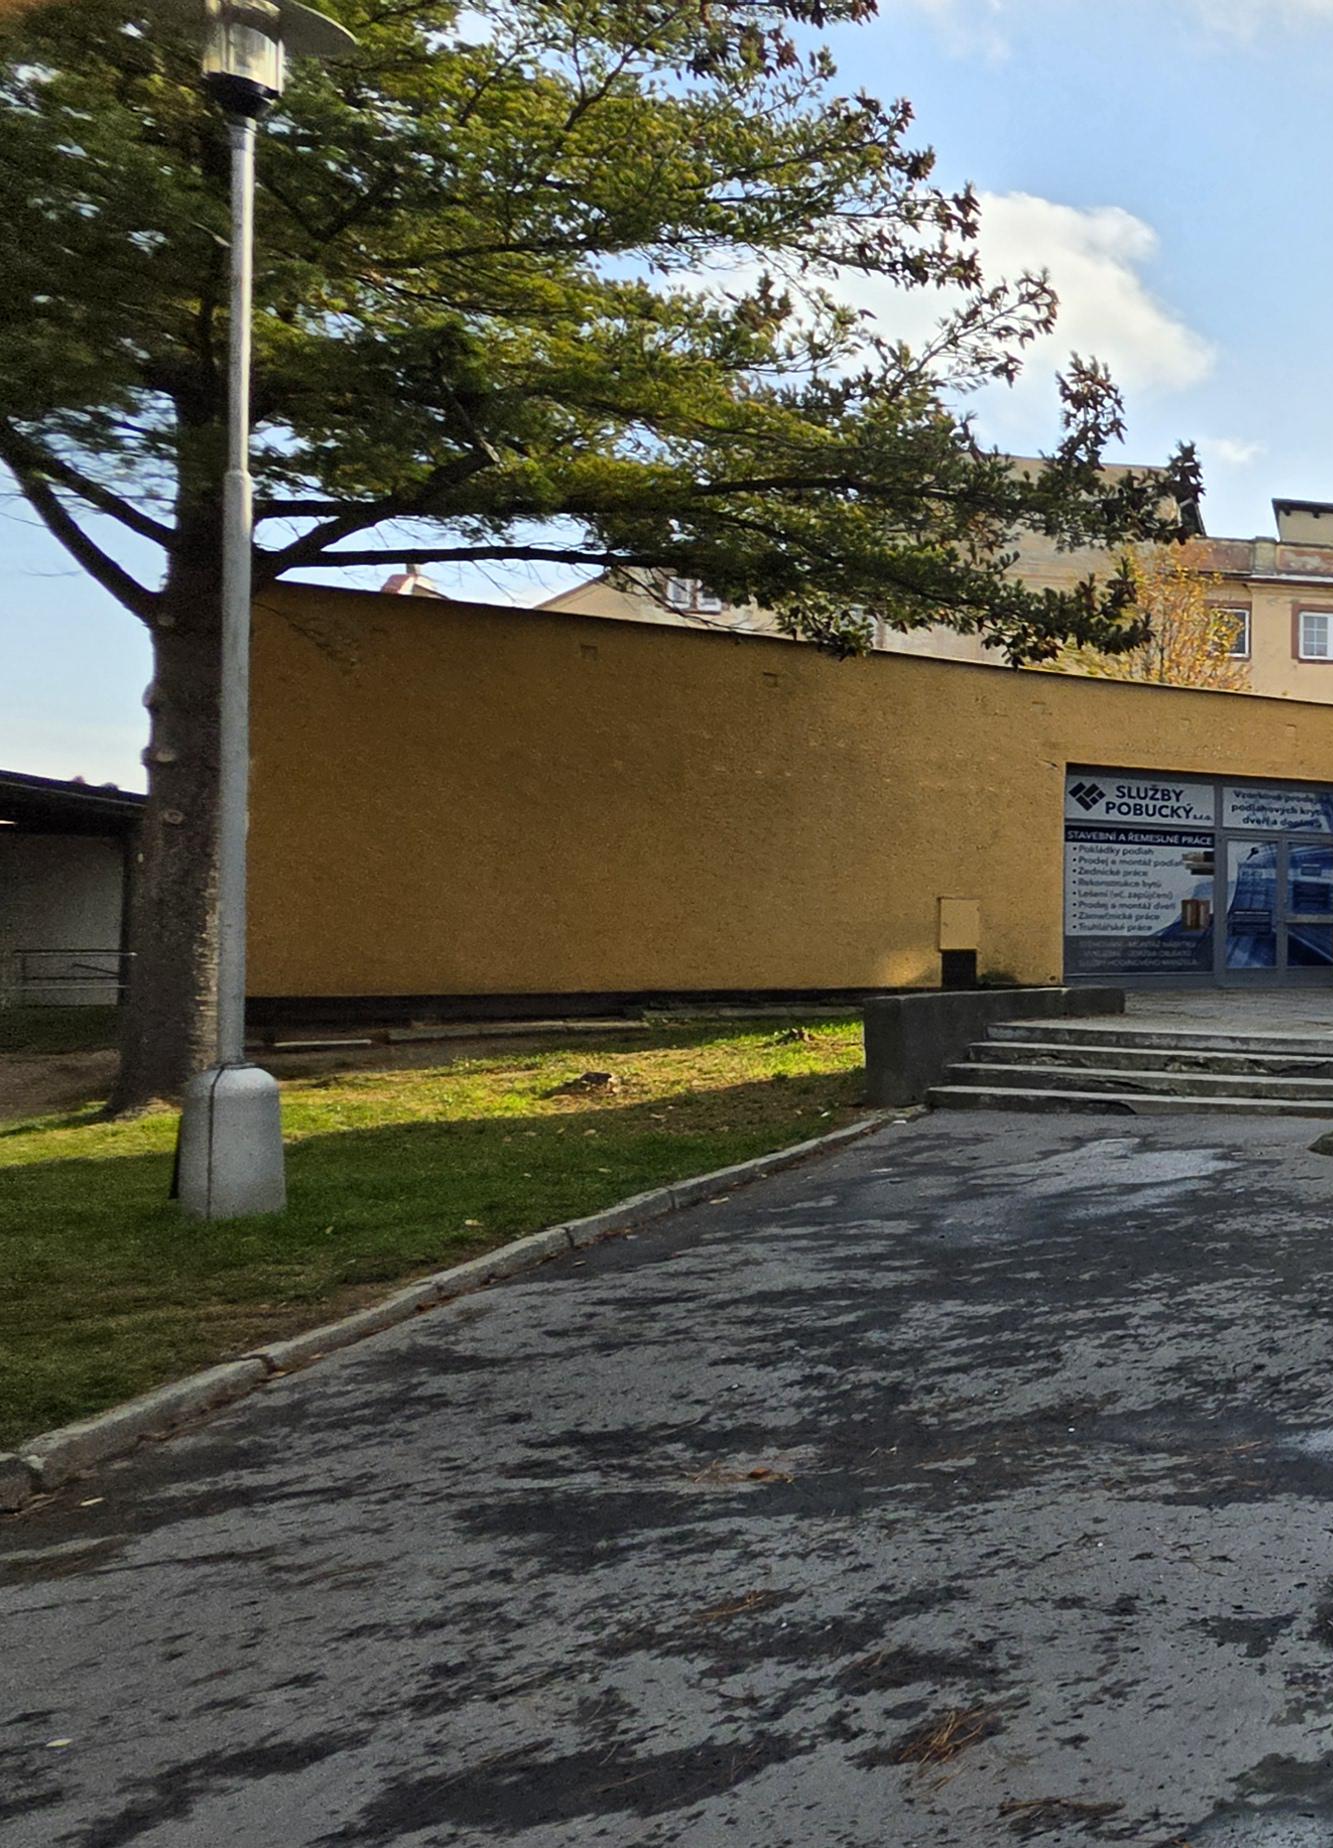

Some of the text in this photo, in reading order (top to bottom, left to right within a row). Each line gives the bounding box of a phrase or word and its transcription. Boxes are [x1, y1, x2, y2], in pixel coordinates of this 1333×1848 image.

[1115, 784, 1185, 802] SLUŽBY
[1105, 801, 1194, 820] POBUCKÝ
[1067, 830, 1213, 846] STAVEBNÍ A ŘEMESLNÉ PRÁCE
[1079, 845, 1154, 856] Pokládky podlah
[1078, 856, 1109, 867] Prodej
[1078, 867, 1148, 877] Zednické práce
[1078, 900, 1109, 910] Prodej
[1135, 913, 1160, 921] práce
[1127, 923, 1153, 933] práce
